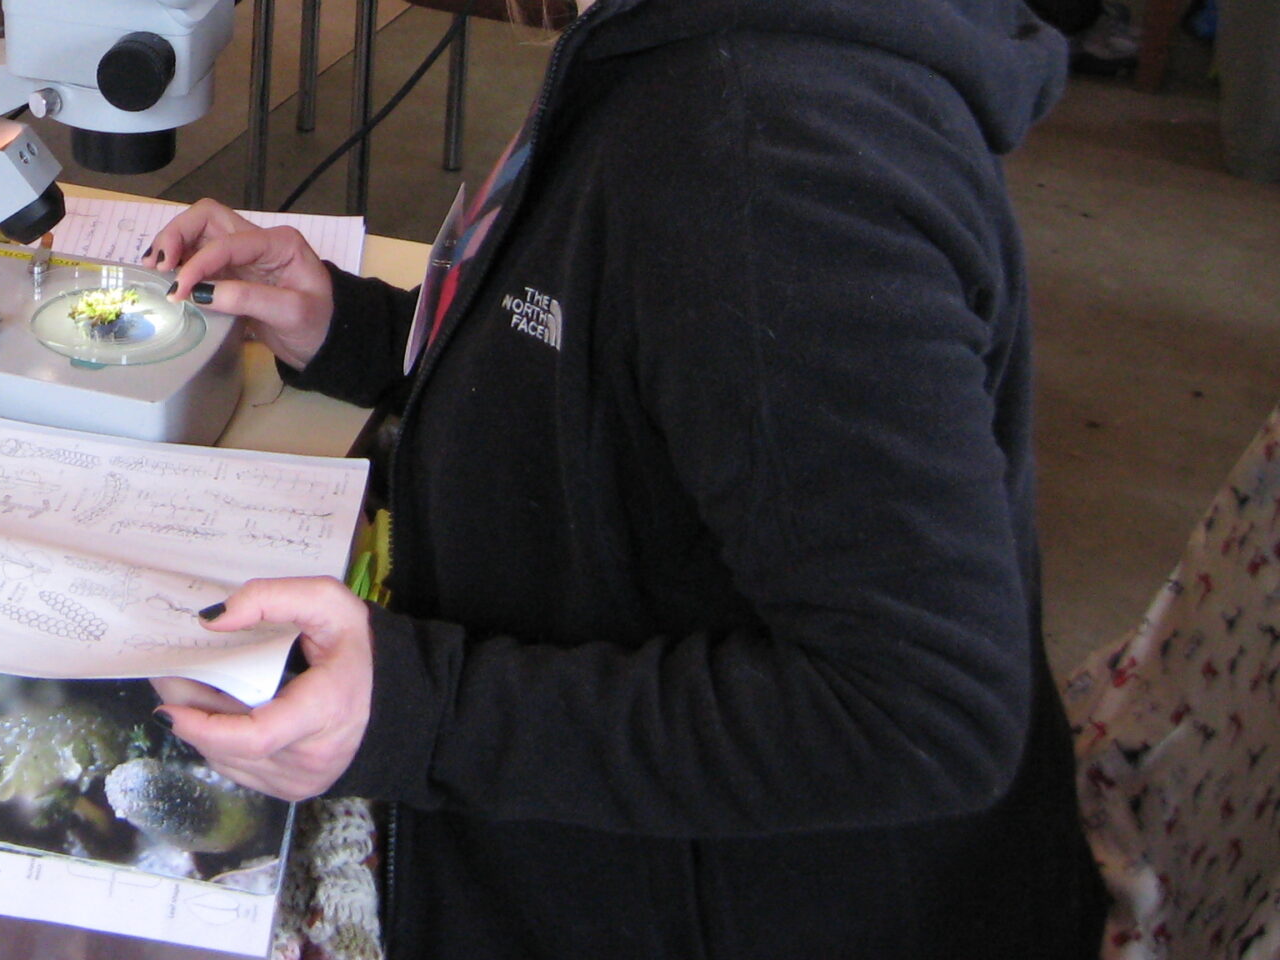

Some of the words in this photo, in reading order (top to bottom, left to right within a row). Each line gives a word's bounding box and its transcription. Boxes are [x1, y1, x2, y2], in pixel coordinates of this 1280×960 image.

[501, 294, 548, 326] NORTH
[524, 287, 550, 310] THE
[511, 314, 545, 340] FACE
